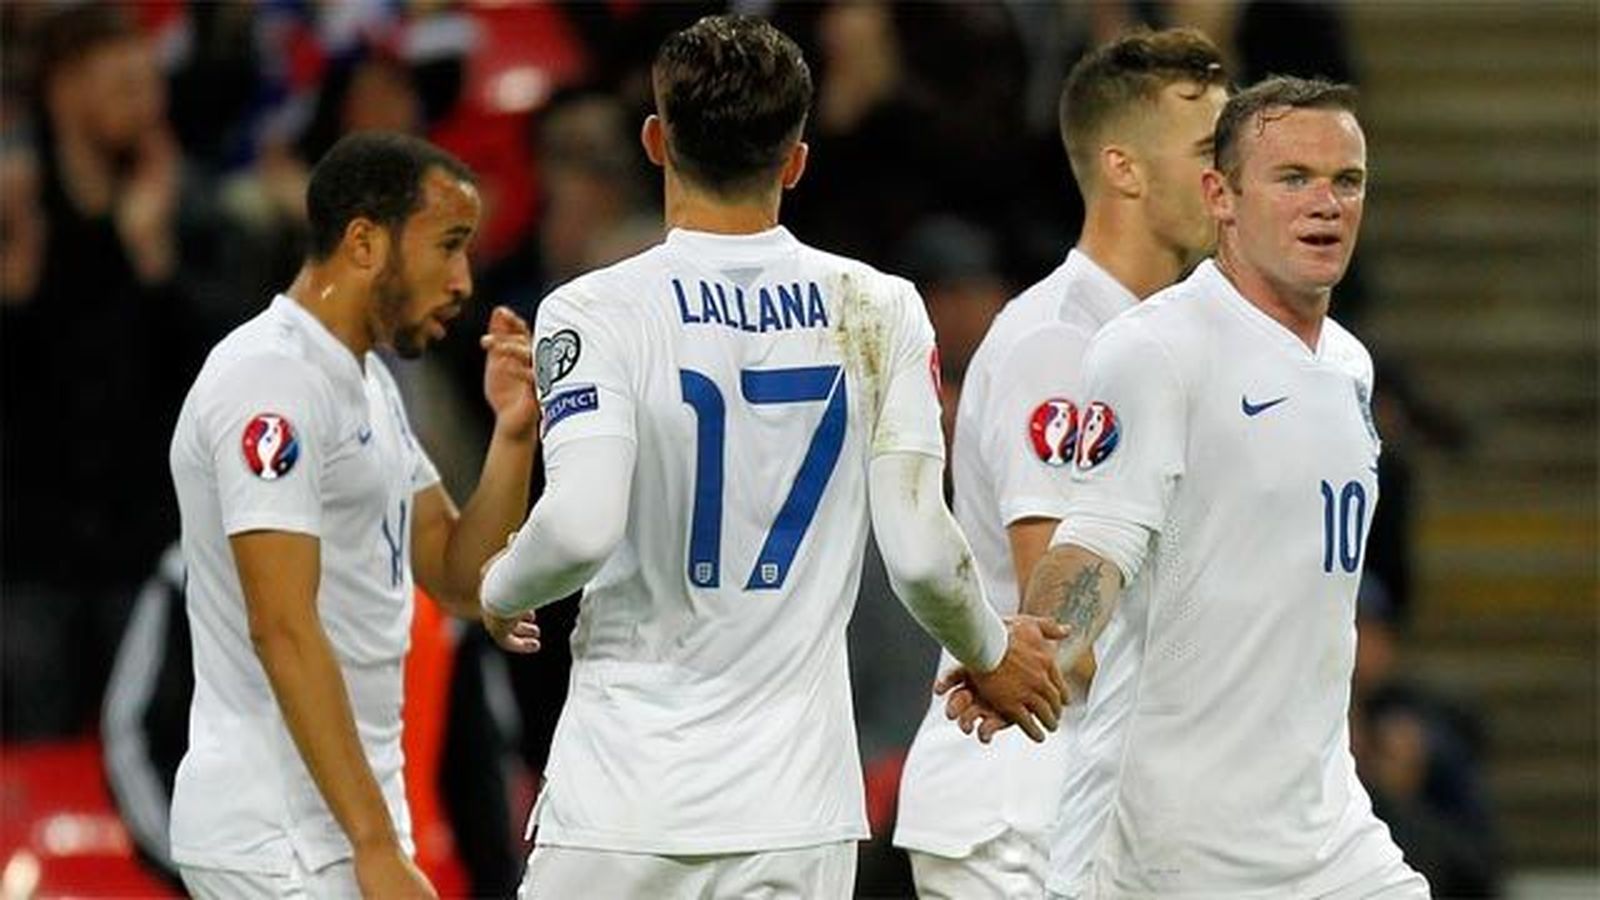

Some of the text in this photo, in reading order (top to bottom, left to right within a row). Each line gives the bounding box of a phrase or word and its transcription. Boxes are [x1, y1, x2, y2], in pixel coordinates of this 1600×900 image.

[672, 279, 828, 333] LALLANA
[679, 365, 848, 590] 17
[1321, 479, 1366, 573] 10
